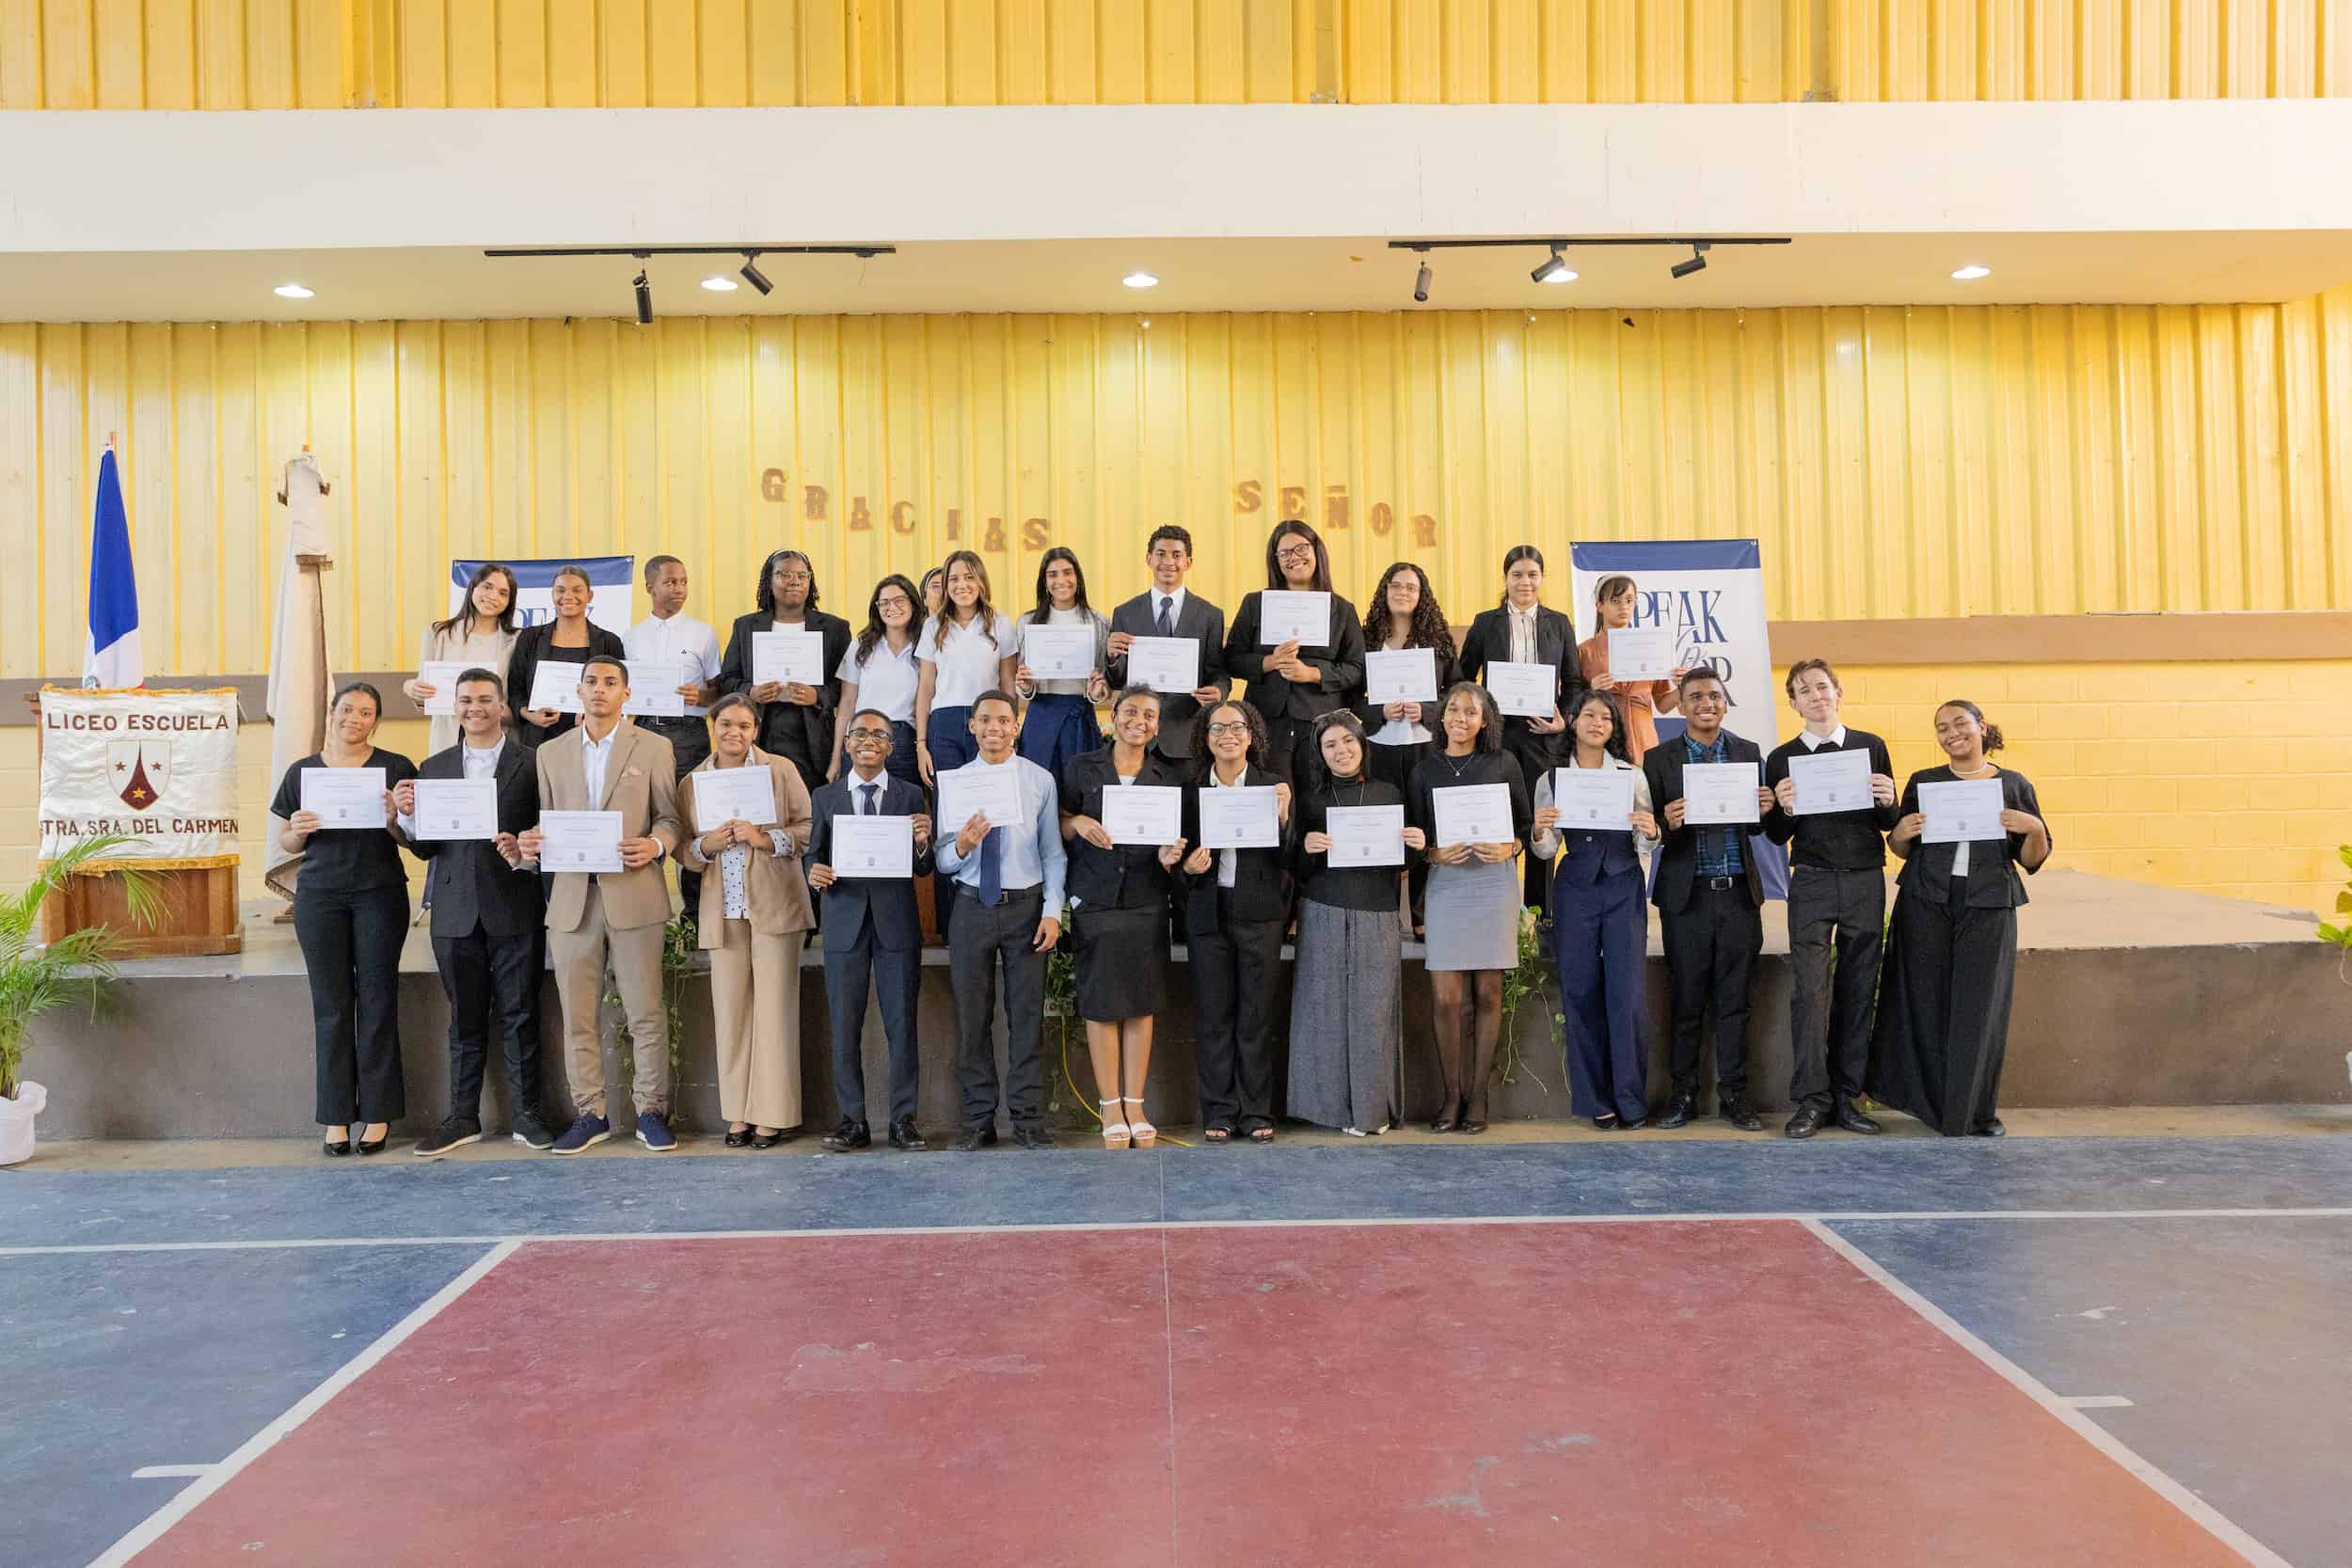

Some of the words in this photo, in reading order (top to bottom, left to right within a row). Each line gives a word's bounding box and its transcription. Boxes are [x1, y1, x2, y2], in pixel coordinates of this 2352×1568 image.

[761, 467, 1049, 552] GRACIAS
[1235, 480, 1437, 548] SEÑOR
[1628, 590, 1728, 643] PEAK
[47, 713, 118, 731] LICEO
[128, 714, 230, 731] ESCUELA
[40, 819, 86, 836] TRA.
[133, 818, 165, 834] DEL
[172, 818, 239, 833] CARMEN
